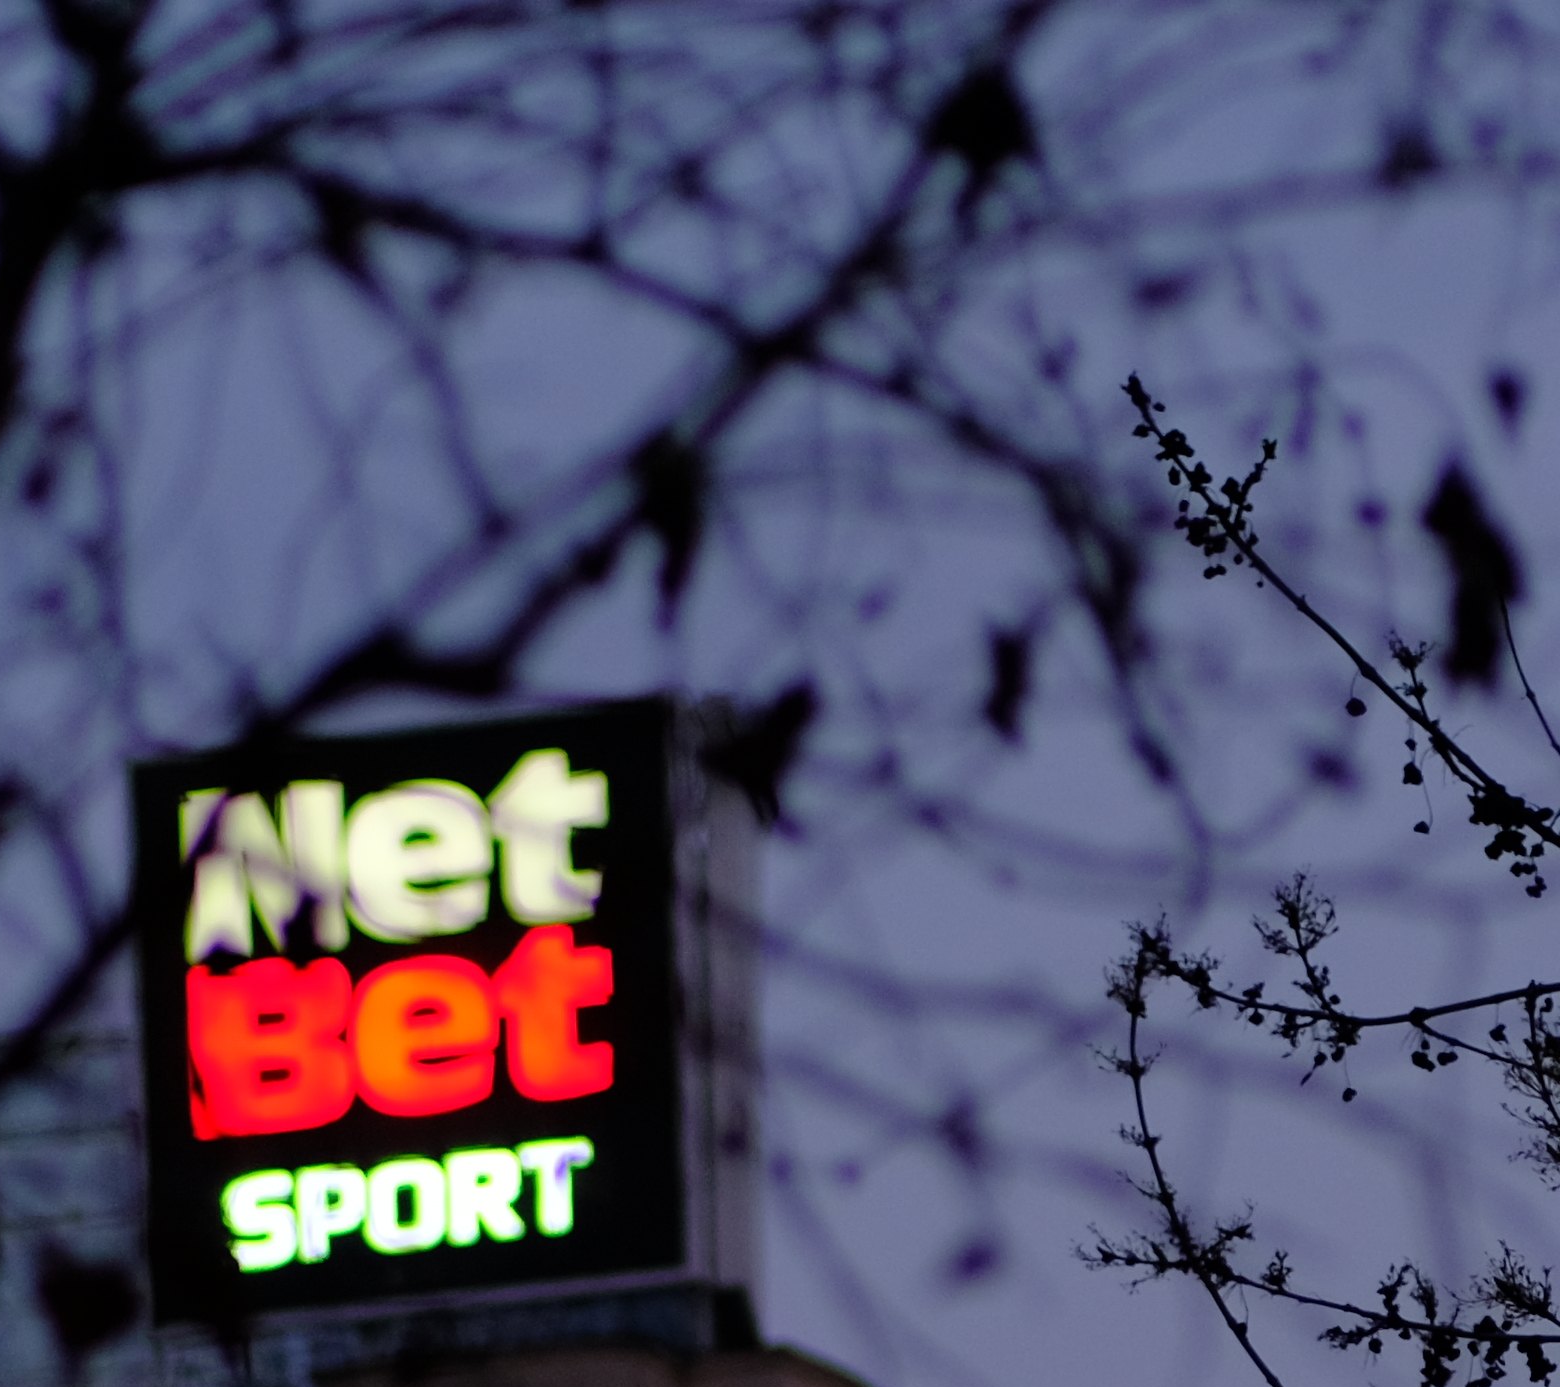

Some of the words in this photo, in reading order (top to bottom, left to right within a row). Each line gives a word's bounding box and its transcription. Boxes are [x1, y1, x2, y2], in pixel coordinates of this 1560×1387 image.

[176, 746, 611, 965] Net
[185, 924, 615, 1142] Bet
[219, 1134, 596, 1274] SPORT
